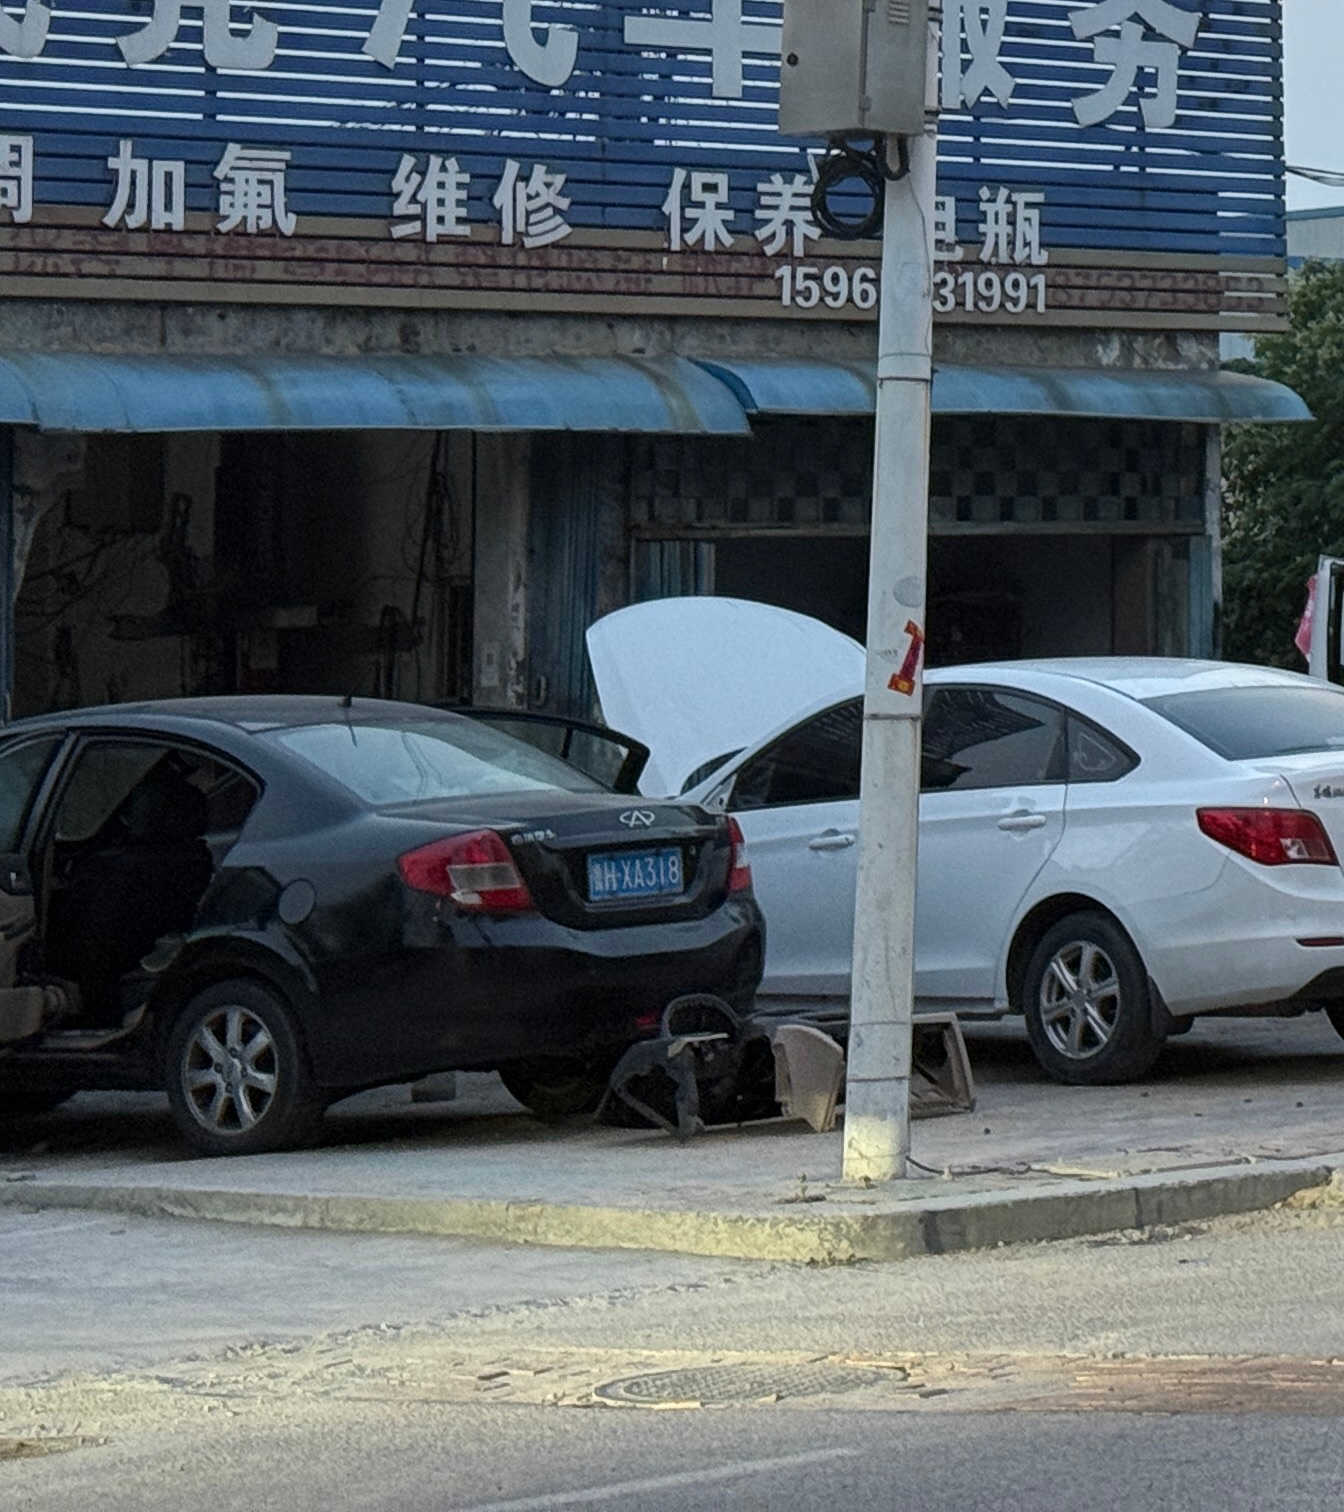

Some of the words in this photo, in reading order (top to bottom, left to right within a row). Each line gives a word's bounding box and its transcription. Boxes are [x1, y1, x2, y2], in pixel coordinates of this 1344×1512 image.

[102, 139, 297, 236] 加氟
[391, 154, 573, 248] 维修
[661, 168, 822, 257] 保养
[774, 265, 1046, 313] 159631991
